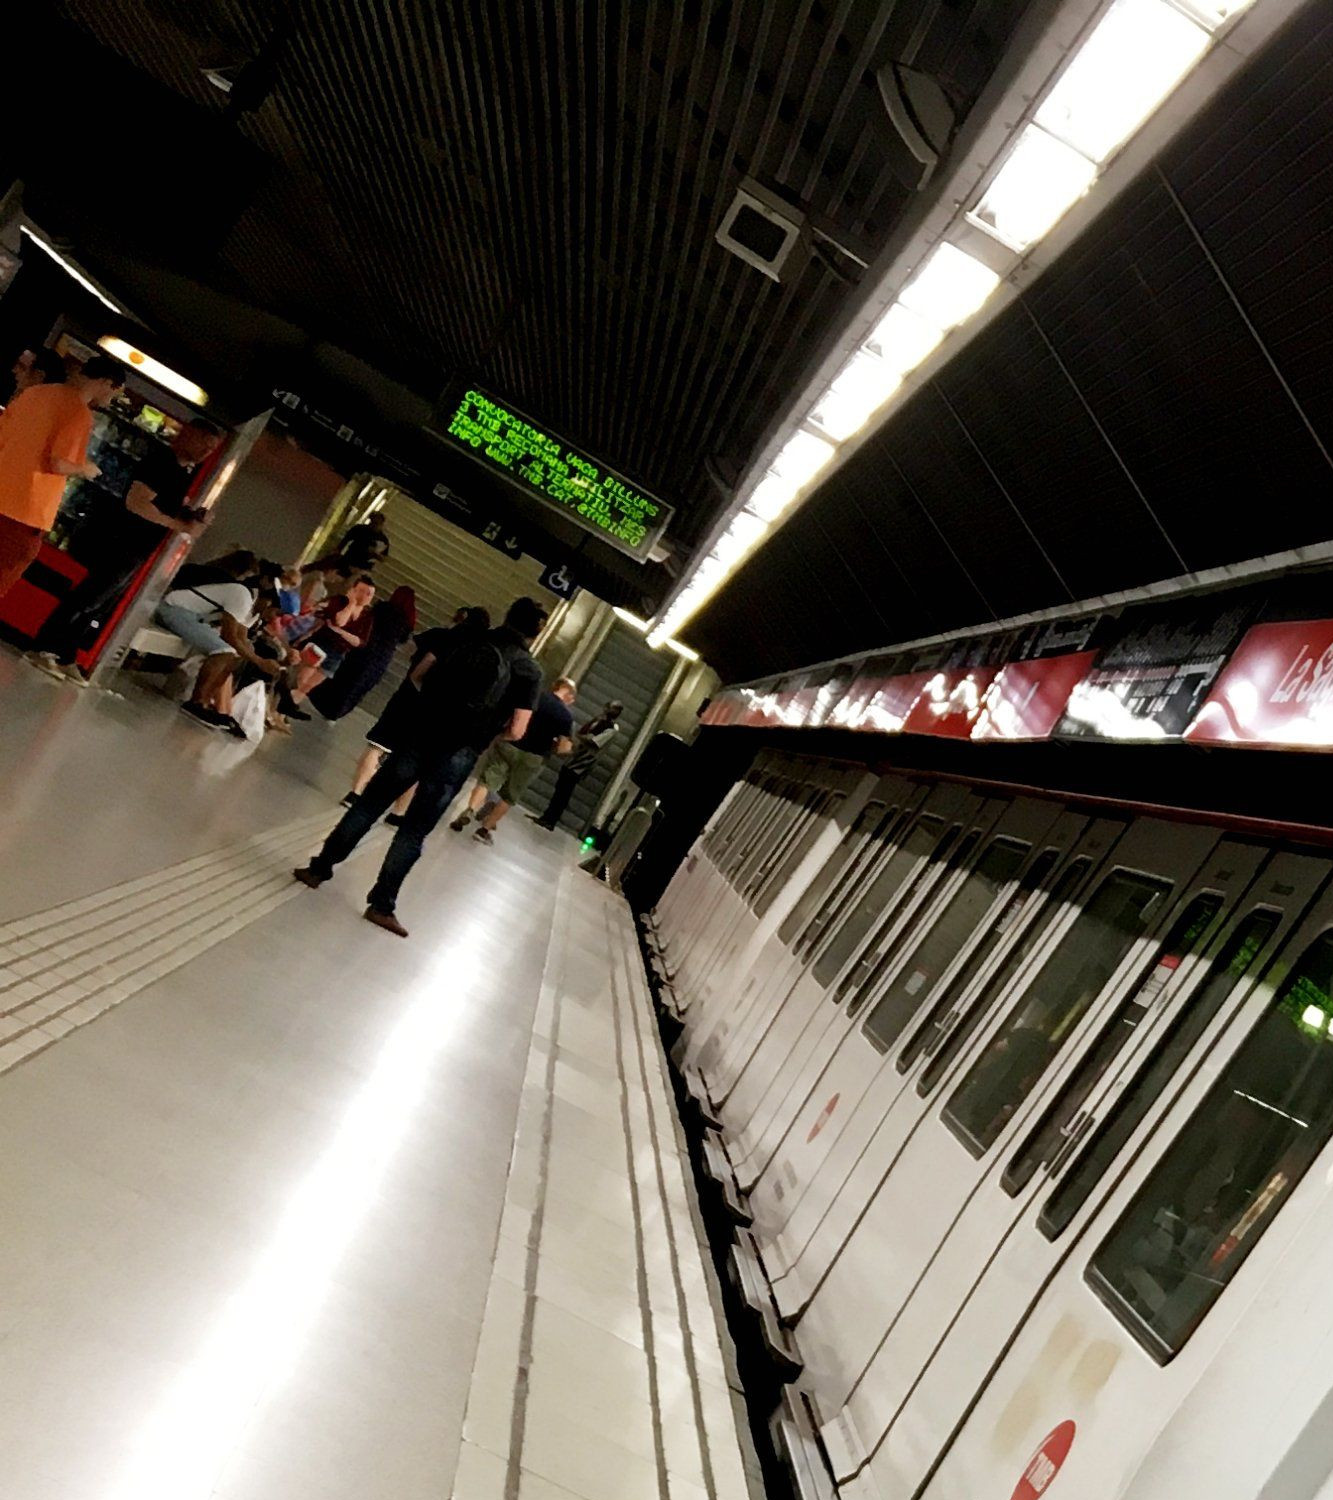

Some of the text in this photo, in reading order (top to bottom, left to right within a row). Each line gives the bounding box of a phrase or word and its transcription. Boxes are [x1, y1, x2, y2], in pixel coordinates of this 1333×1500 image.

[459, 400, 470, 413] 3
[476, 409, 501, 432] TMB
[447, 421, 482, 448] INFO
[453, 411, 526, 460] TRANSPORT
[566, 452, 599, 479] VAGA
[1269, 644, 1313, 703] La
